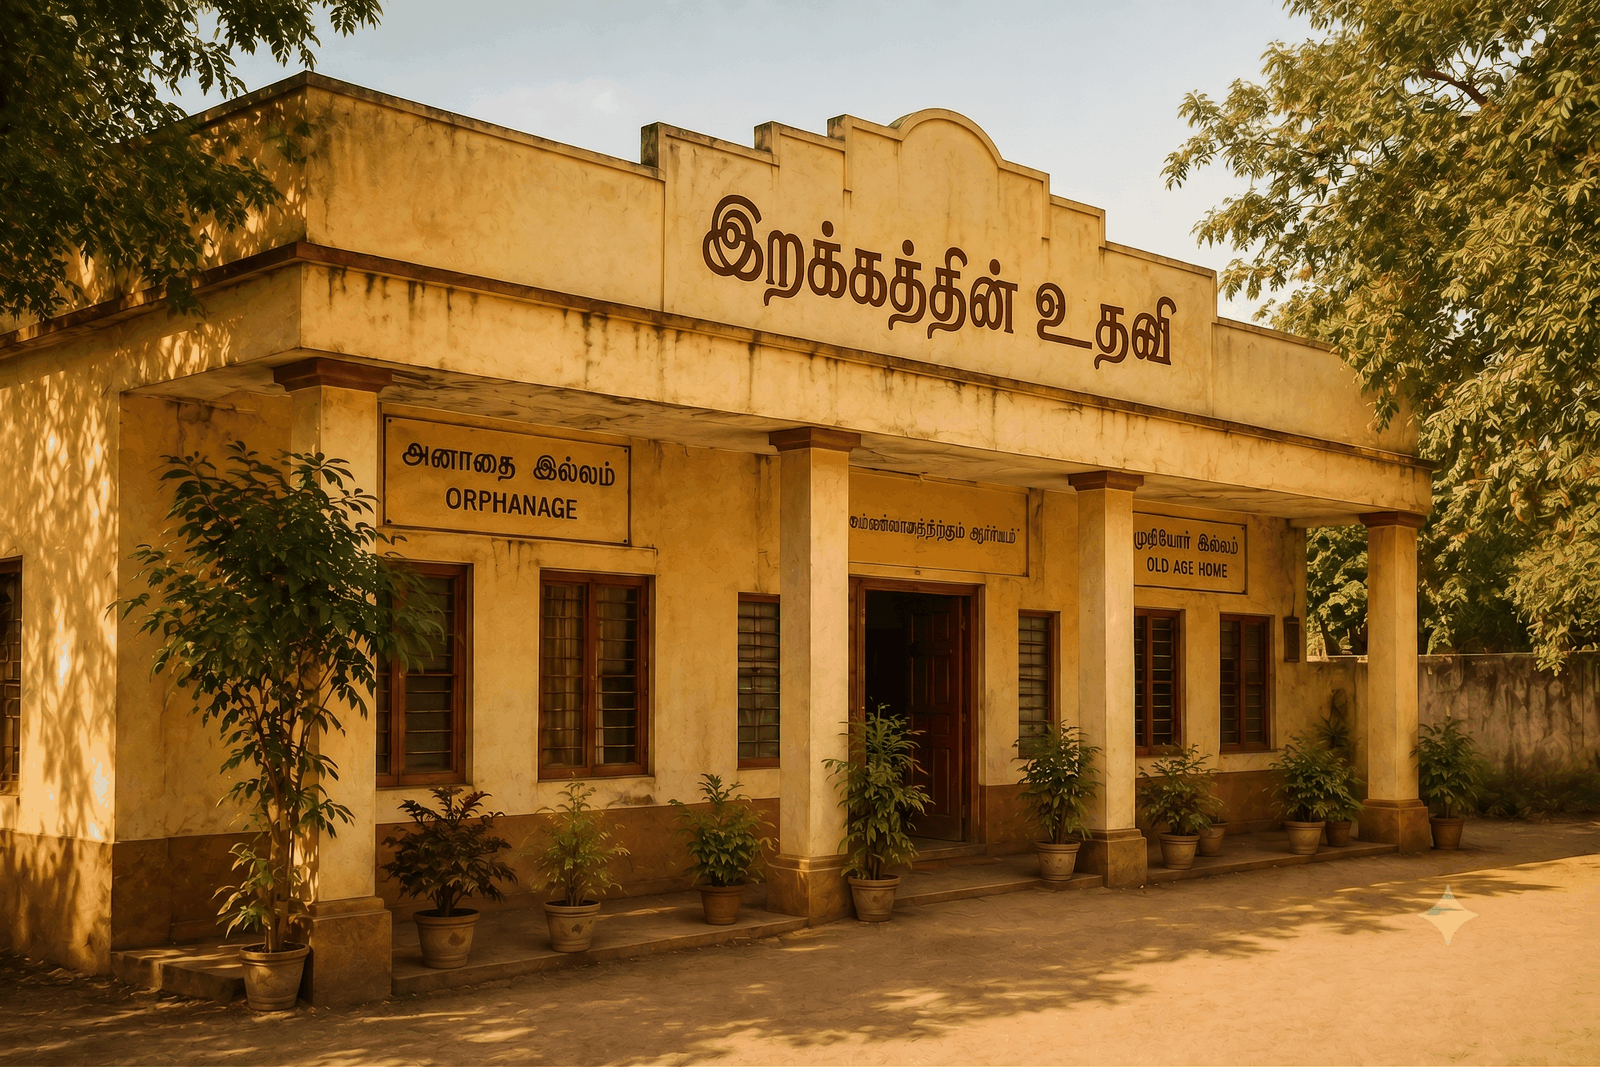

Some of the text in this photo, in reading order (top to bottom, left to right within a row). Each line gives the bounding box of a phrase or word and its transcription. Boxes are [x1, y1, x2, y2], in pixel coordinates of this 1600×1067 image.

[702, 193, 1019, 339] இறக்கத்தின்
[401, 442, 616, 487] அனாதை இல்லம்
[445, 487, 578, 520] ORPHANAGE
[1197, 533, 1239, 555] இல்லம்
[1146, 556, 1228, 579] OLD AGE HOME
